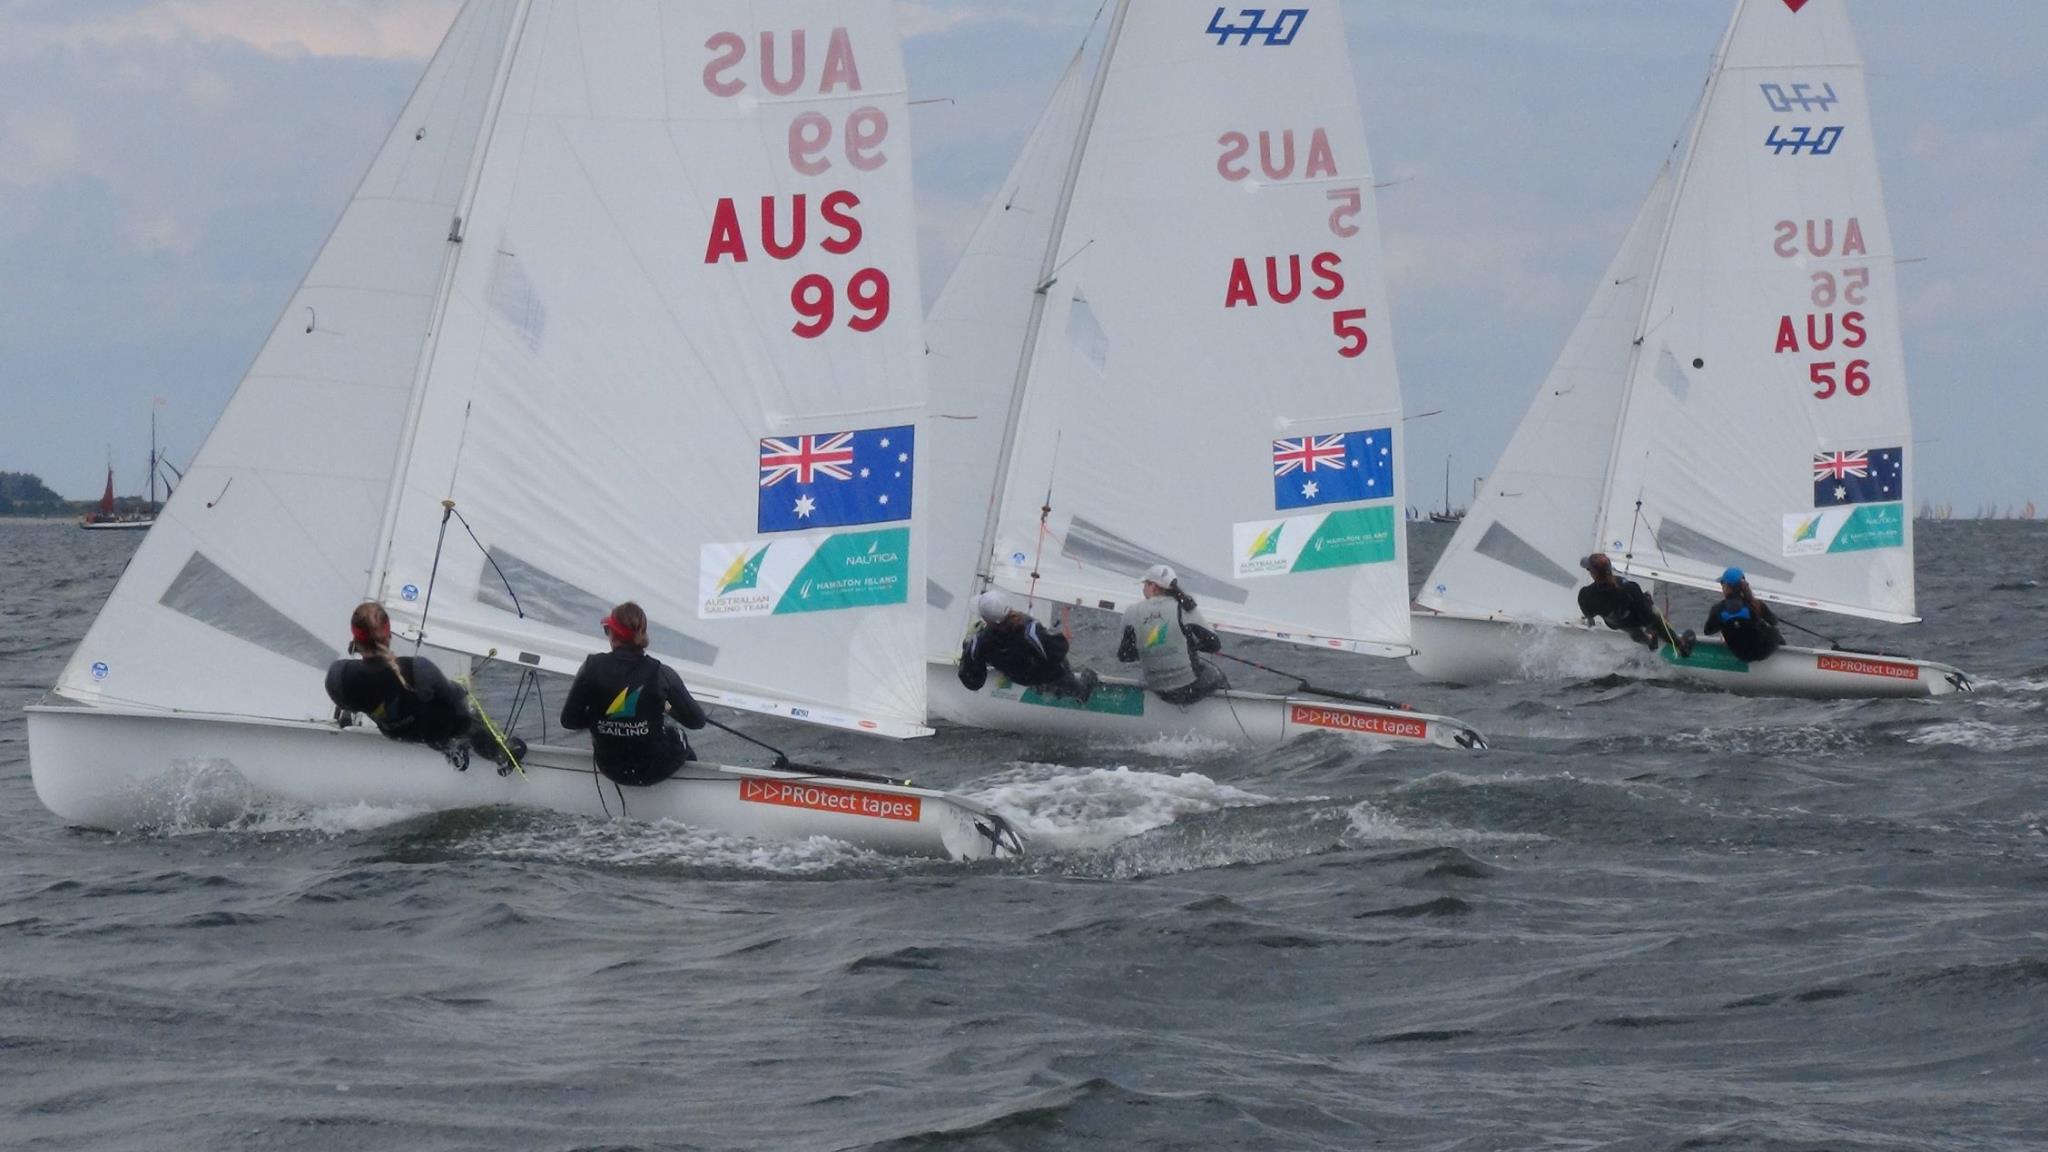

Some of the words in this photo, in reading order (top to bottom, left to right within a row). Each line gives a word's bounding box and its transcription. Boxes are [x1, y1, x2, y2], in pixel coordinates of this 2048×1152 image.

[1205, 7, 1309, 46] 470
[1764, 125, 1845, 155] 470
[704, 190, 862, 264] AUS
[1225, 252, 1344, 307] AUS
[791, 267, 890, 338] 99
[1333, 308, 1367, 358] 5
[1775, 311, 1867, 353] AUS
[1809, 359, 1871, 400] 56
[846, 552, 898, 566] NAUTICA
[864, 575, 897, 586] ISLAND
[704, 604, 741, 614] SAILING
[744, 602, 769, 612] TEAM
[705, 595, 769, 606] AUSTRALIAN
[1840, 660, 1883, 673] PROtect
[1886, 667, 1915, 678] tapes
[598, 719, 648, 729] AUSTRALIAN
[598, 726, 649, 736] SAILING
[1322, 712, 1378, 730] PROtect
[1382, 720, 1421, 735] tapes
[781, 785, 856, 810] PROtect
[862, 796, 913, 817] tapes
